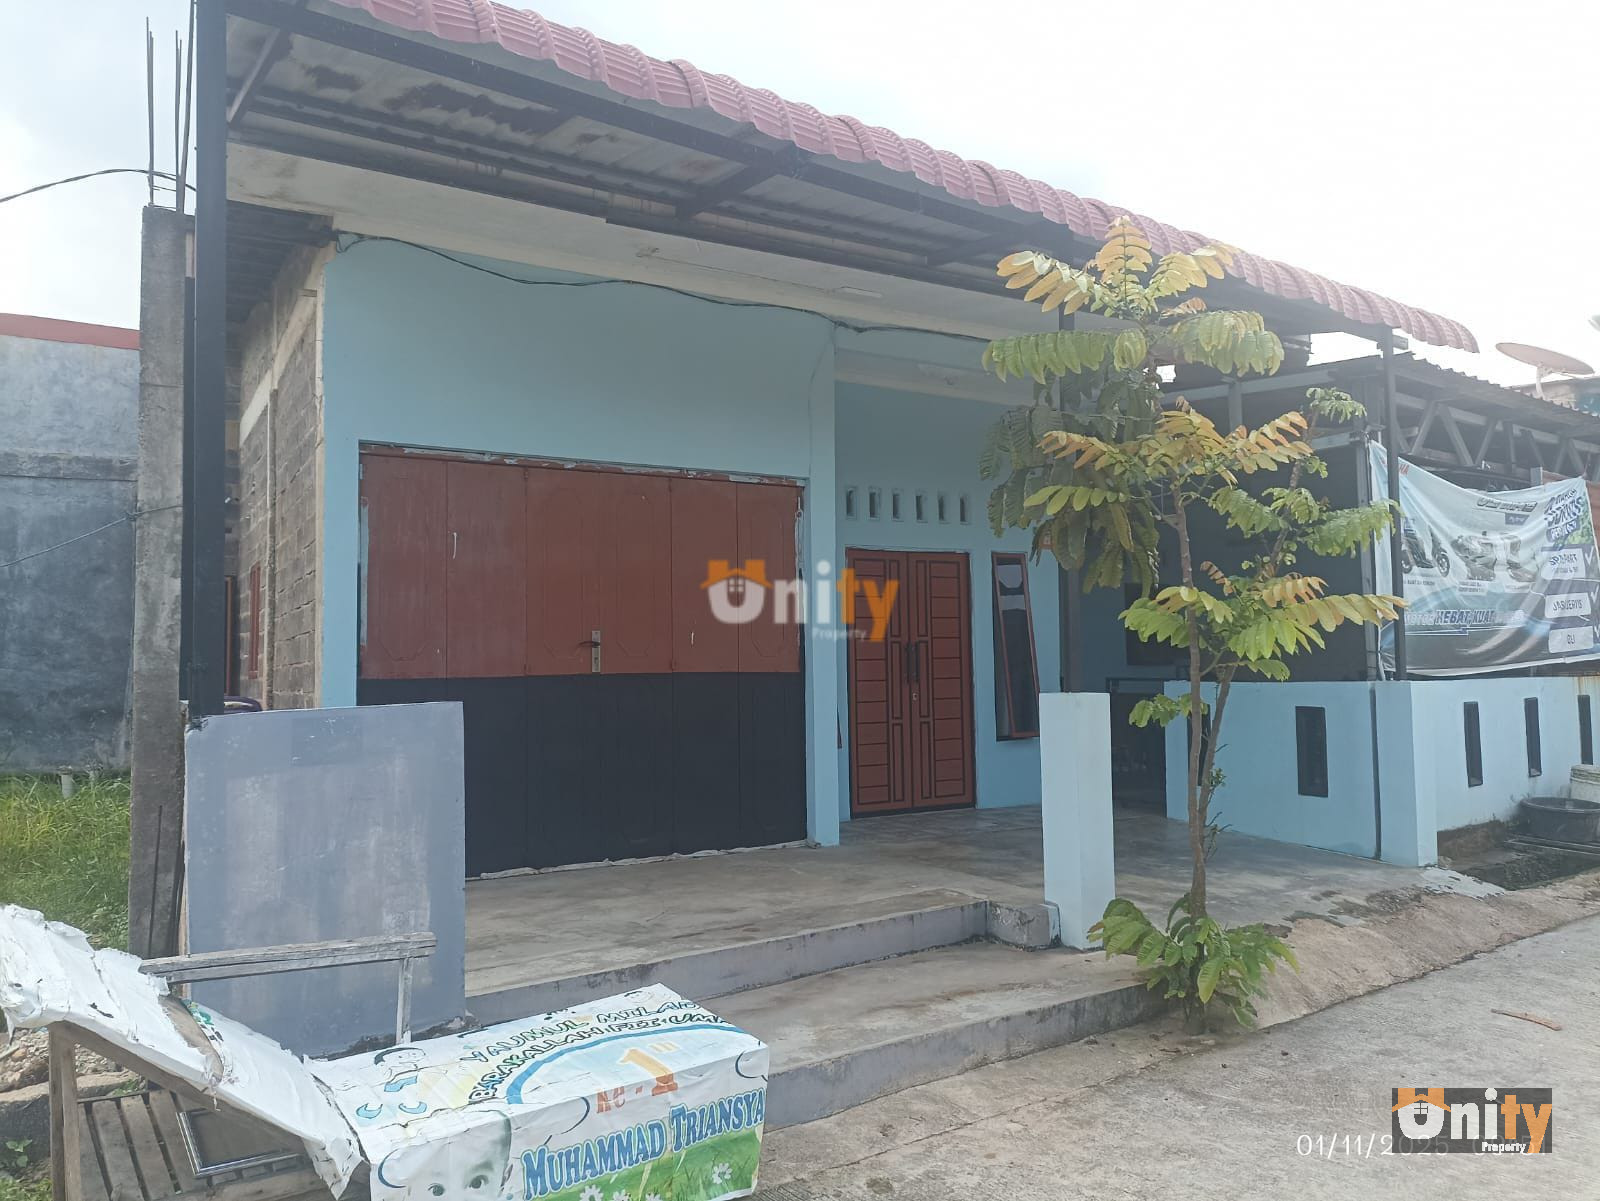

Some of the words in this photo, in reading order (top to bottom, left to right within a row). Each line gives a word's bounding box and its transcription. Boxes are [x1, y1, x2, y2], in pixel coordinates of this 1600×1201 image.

[459, 1019, 589, 1063] YAUMUL
[596, 1001, 697, 1024] MILAD
[467, 1026, 604, 1103] BARAKALLAH
[521, 1119, 667, 1200] MUHAMMAD
[670, 1088, 767, 1152] TRIANSYA
